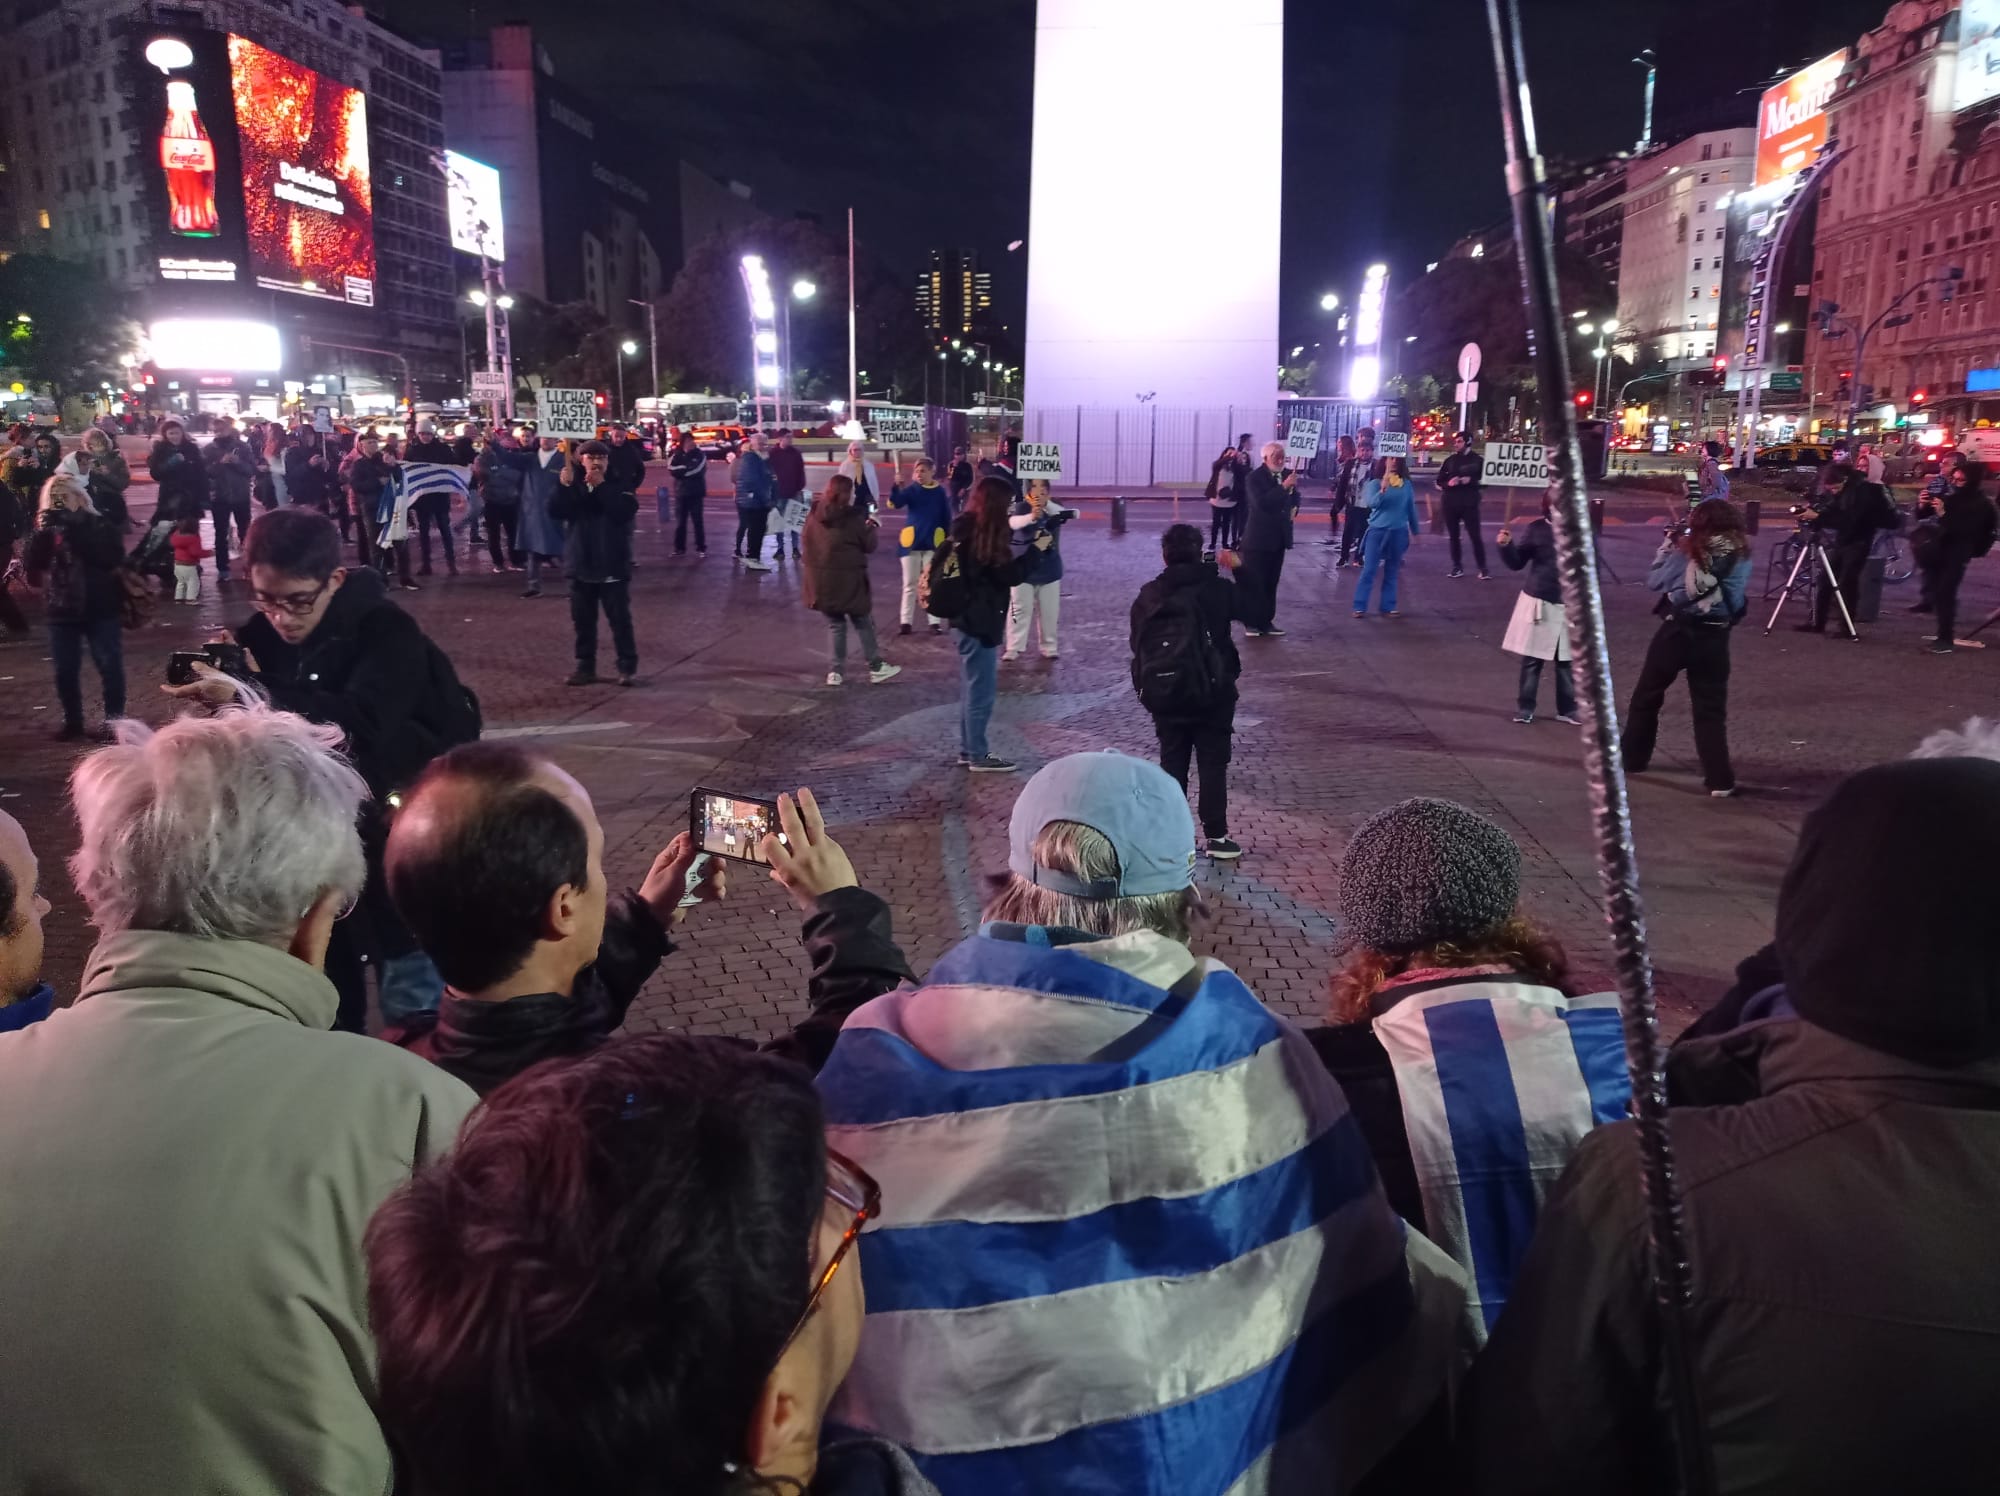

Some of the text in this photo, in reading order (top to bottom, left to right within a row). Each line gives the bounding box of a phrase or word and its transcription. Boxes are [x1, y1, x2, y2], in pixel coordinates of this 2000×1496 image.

[546, 390, 594, 404] LUCHAR
[551, 403, 593, 418] HASTA
[547, 417, 593, 432] VENCER
[879, 419, 918, 432] FABRICA
[1292, 420, 1318, 434] NO AL
[881, 432, 921, 444] TOMADA
[1290, 435, 1316, 450] GOLPE
[1020, 444, 1060, 457] NO A LA
[1380, 443, 1405, 453] TOMADA
[1498, 444, 1542, 461] LICEO
[1019, 458, 1062, 473] REFORMA
[1485, 461, 1549, 478] OCUPADO
